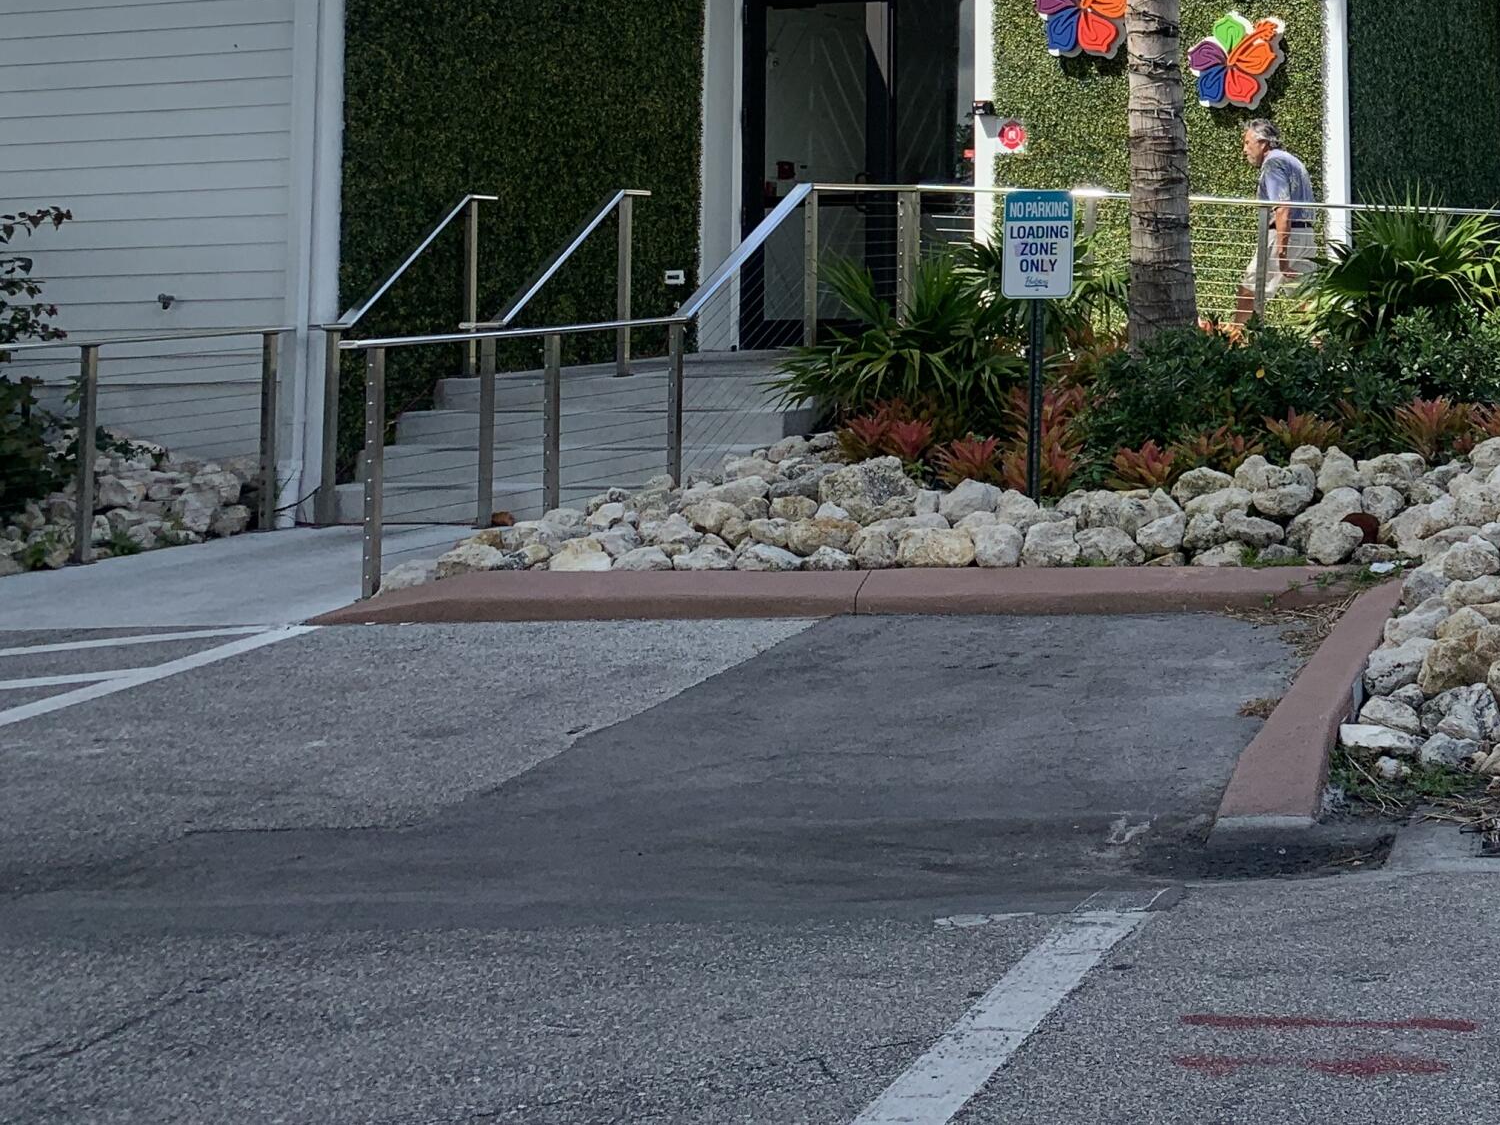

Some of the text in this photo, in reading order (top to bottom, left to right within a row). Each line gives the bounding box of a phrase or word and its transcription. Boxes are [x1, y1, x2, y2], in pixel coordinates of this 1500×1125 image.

[1008, 130, 1017, 140] R
[1009, 201, 1069, 218] NO PARKING
[1010, 225, 1069, 239] LOADING
[1020, 242, 1058, 256] ZONE
[1020, 258, 1058, 272] ONLY
